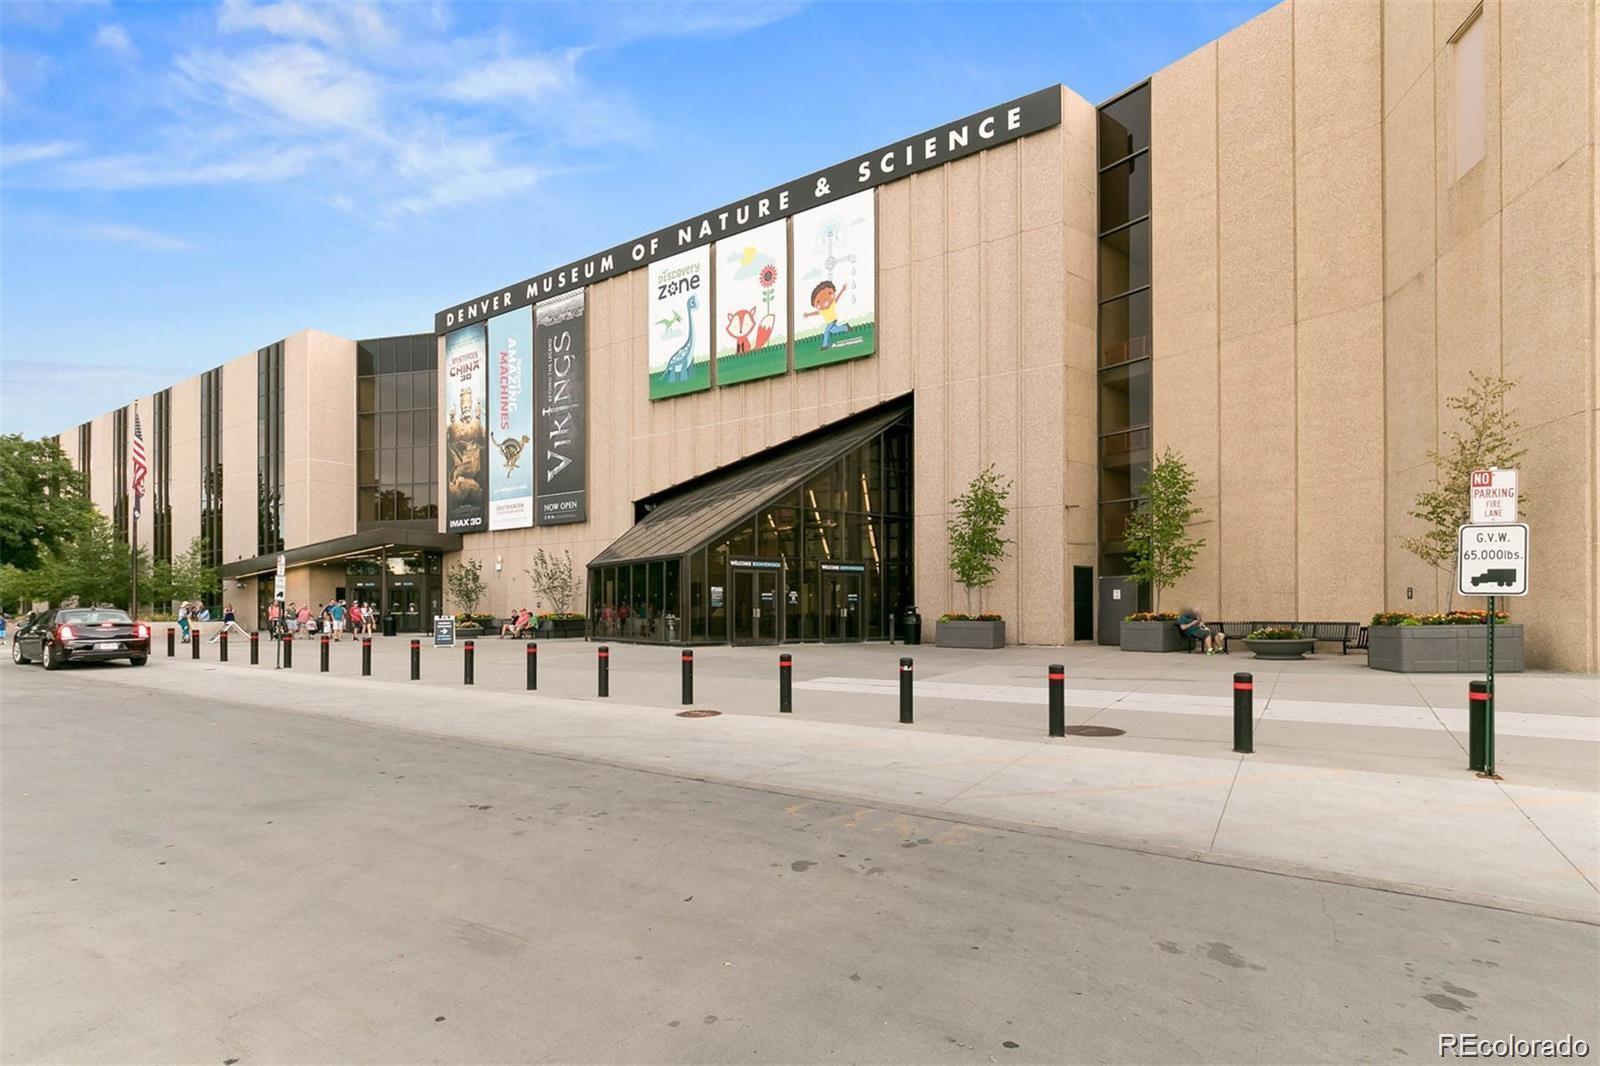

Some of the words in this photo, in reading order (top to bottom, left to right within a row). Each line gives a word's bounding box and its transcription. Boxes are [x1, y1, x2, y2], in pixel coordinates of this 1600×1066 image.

[446, 292, 512, 327] DENVER
[526, 253, 615, 296] MUSEUM
[631, 237, 660, 262] OF
[677, 190, 790, 246] NATURE
[814, 176, 831, 197] &
[859, 106, 1023, 182] SCIENCE
[449, 360, 480, 377] CHINA
[506, 337, 517, 412] AMAZING
[499, 351, 509, 430] MACHINES
[542, 330, 578, 482] VIKINGS
[1474, 472, 1490, 485] NO
[1474, 487, 1515, 499] PARKING
[544, 502, 559, 512] NOW
[560, 500, 578, 510] OPEN
[1486, 499, 1501, 508] FIRE
[1484, 508, 1503, 518] LANE
[449, 518, 470, 528] IMAX
[470, 517, 482, 526] 3D
[1476, 532, 1511, 543] G.V.W.
